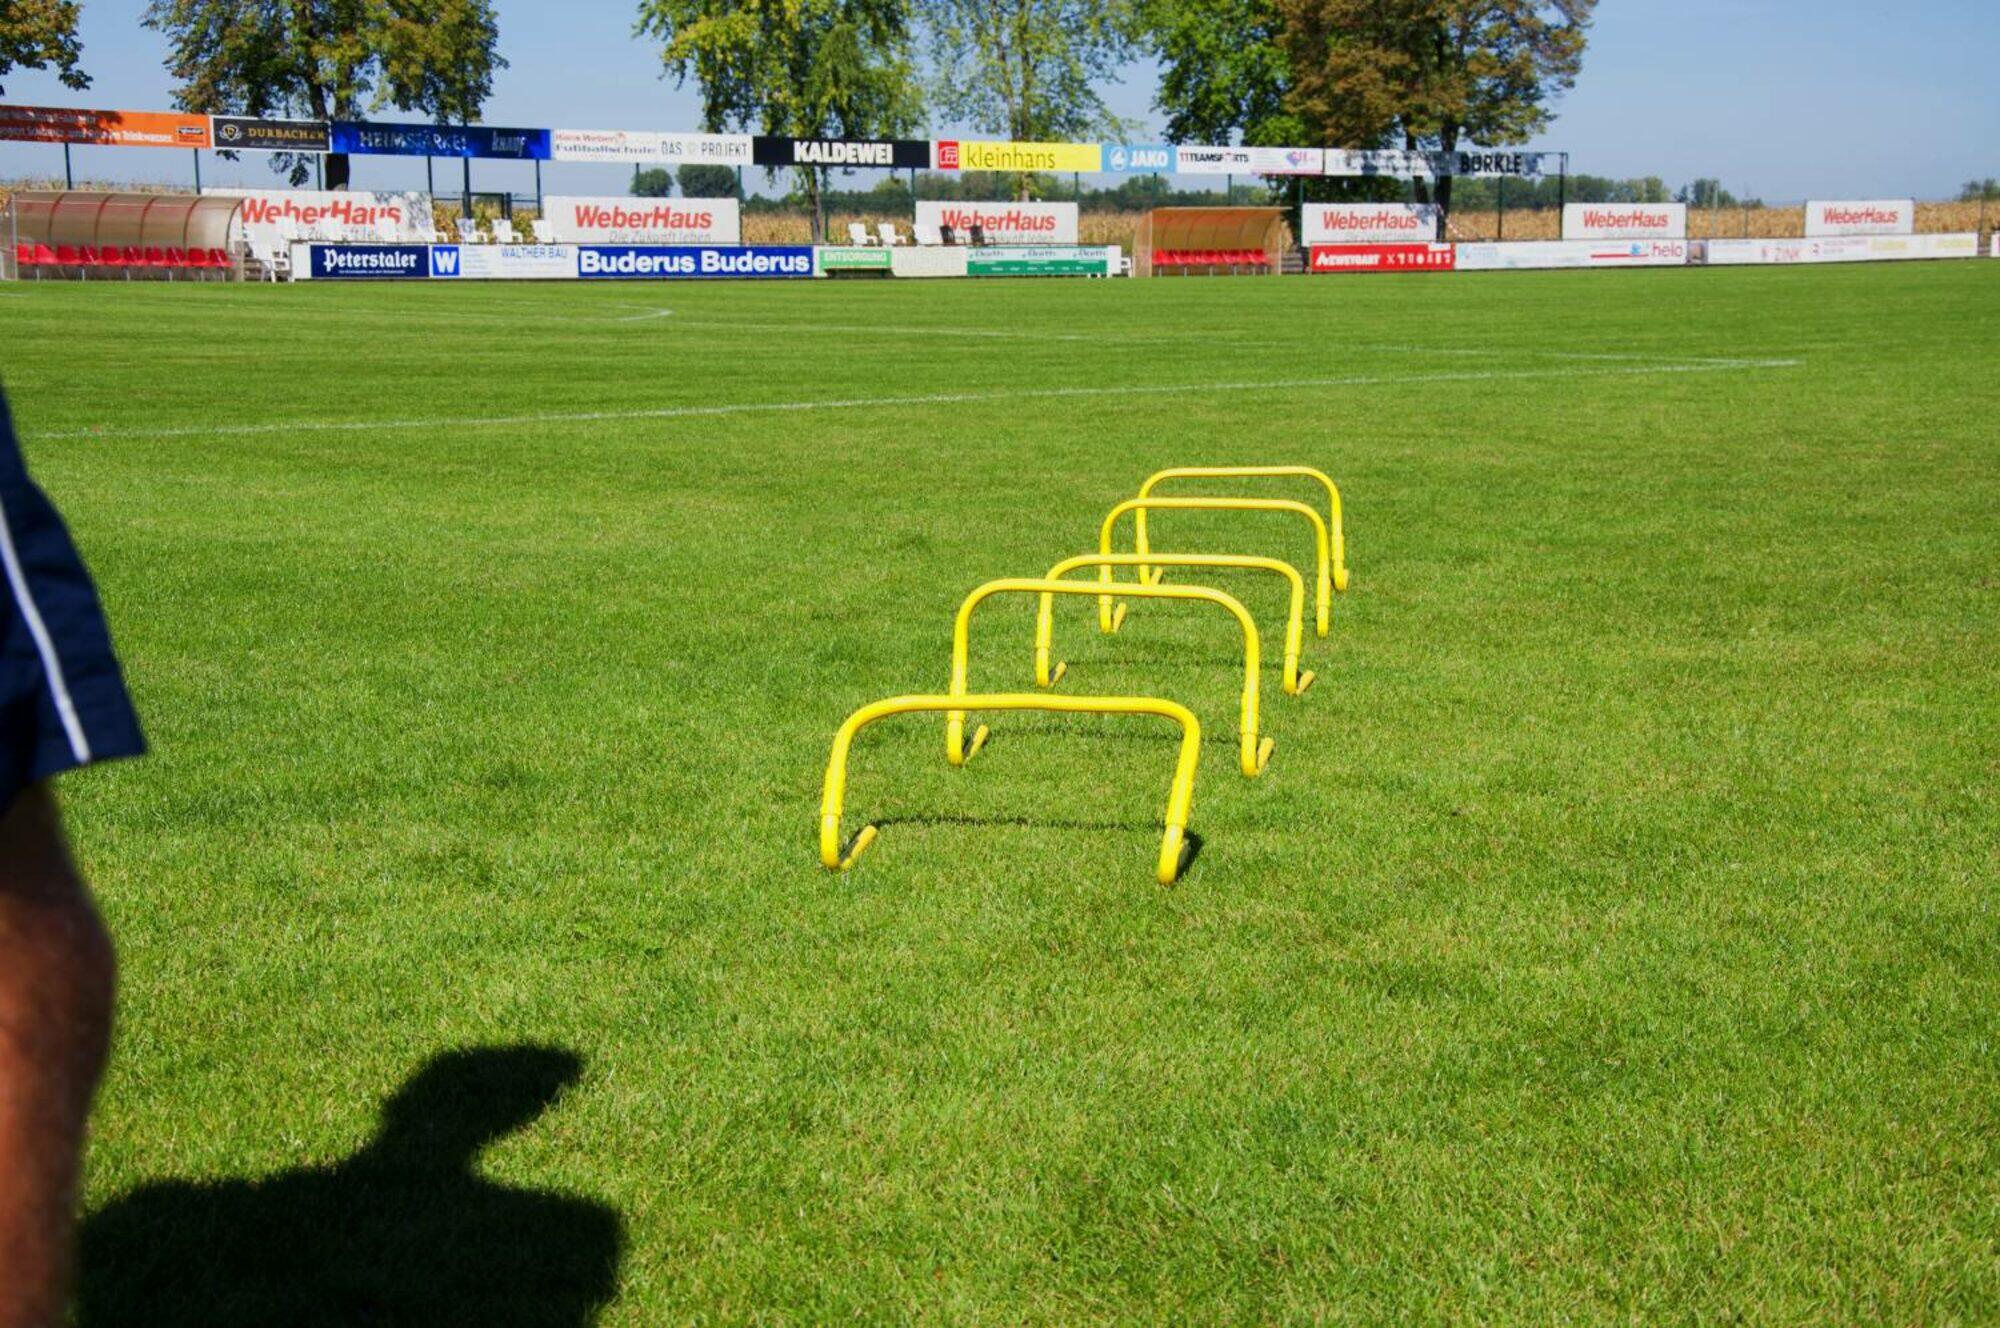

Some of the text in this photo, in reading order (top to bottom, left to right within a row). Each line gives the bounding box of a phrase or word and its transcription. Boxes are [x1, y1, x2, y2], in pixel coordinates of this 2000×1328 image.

[662, 141, 682, 156] DAS
[702, 143, 747, 157] PROJEKT
[794, 141, 893, 164] KALDEWEI
[967, 144, 1056, 169] kleinhans
[1130, 149, 1169, 167] JAKO
[575, 204, 713, 229] WeberHaus
[941, 209, 1056, 232] WeberHaus
[1323, 211, 1418, 230] WeberHaus
[1583, 210, 1669, 228] WeberHaus
[1824, 207, 1898, 224] WeberHaus
[323, 248, 416, 272] Peterstaler
[434, 251, 458, 273] W
[501, 247, 545, 258] WALTHER
[579, 250, 696, 273] Buderus
[699, 250, 810, 273] Buderus
